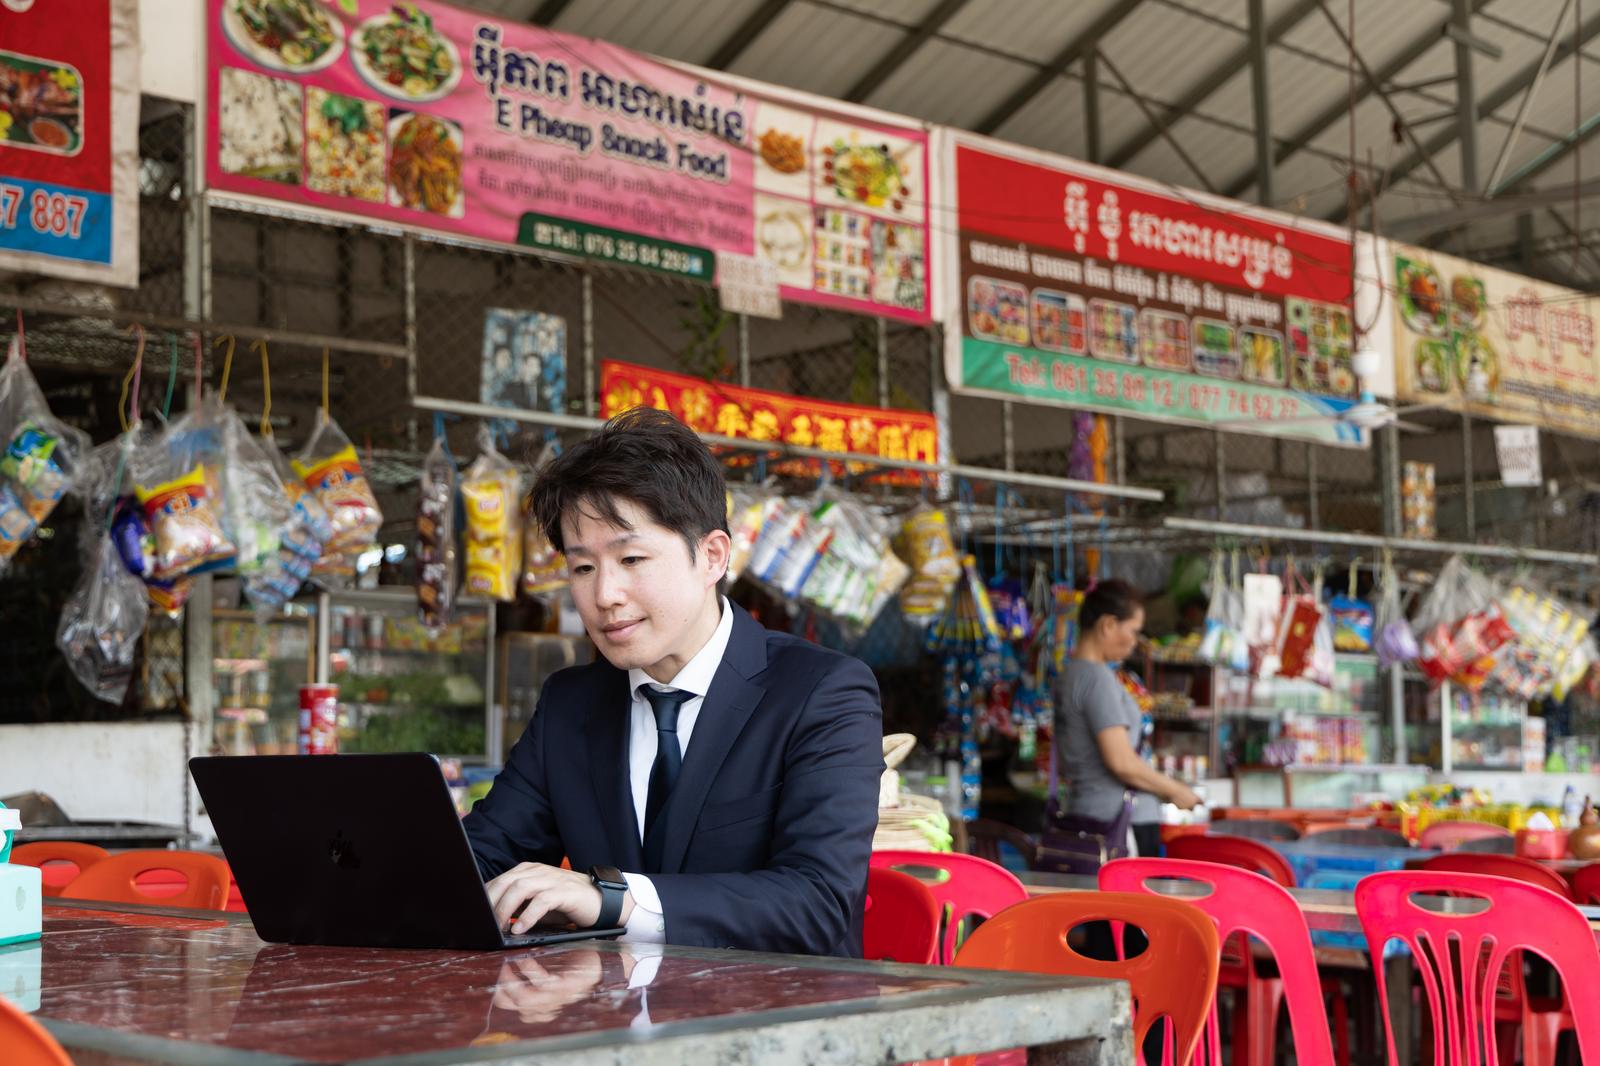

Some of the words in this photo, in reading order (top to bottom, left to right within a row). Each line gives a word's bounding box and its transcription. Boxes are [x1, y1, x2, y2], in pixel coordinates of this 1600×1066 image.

[497, 99, 511, 127] E
[521, 105, 592, 150] Pheap
[602, 123, 668, 163] Snack
[677, 143, 727, 178] Food
[0, 183, 24, 229] 7
[30, 188, 88, 240] 887
[1005, 353, 1047, 387] Tel:
